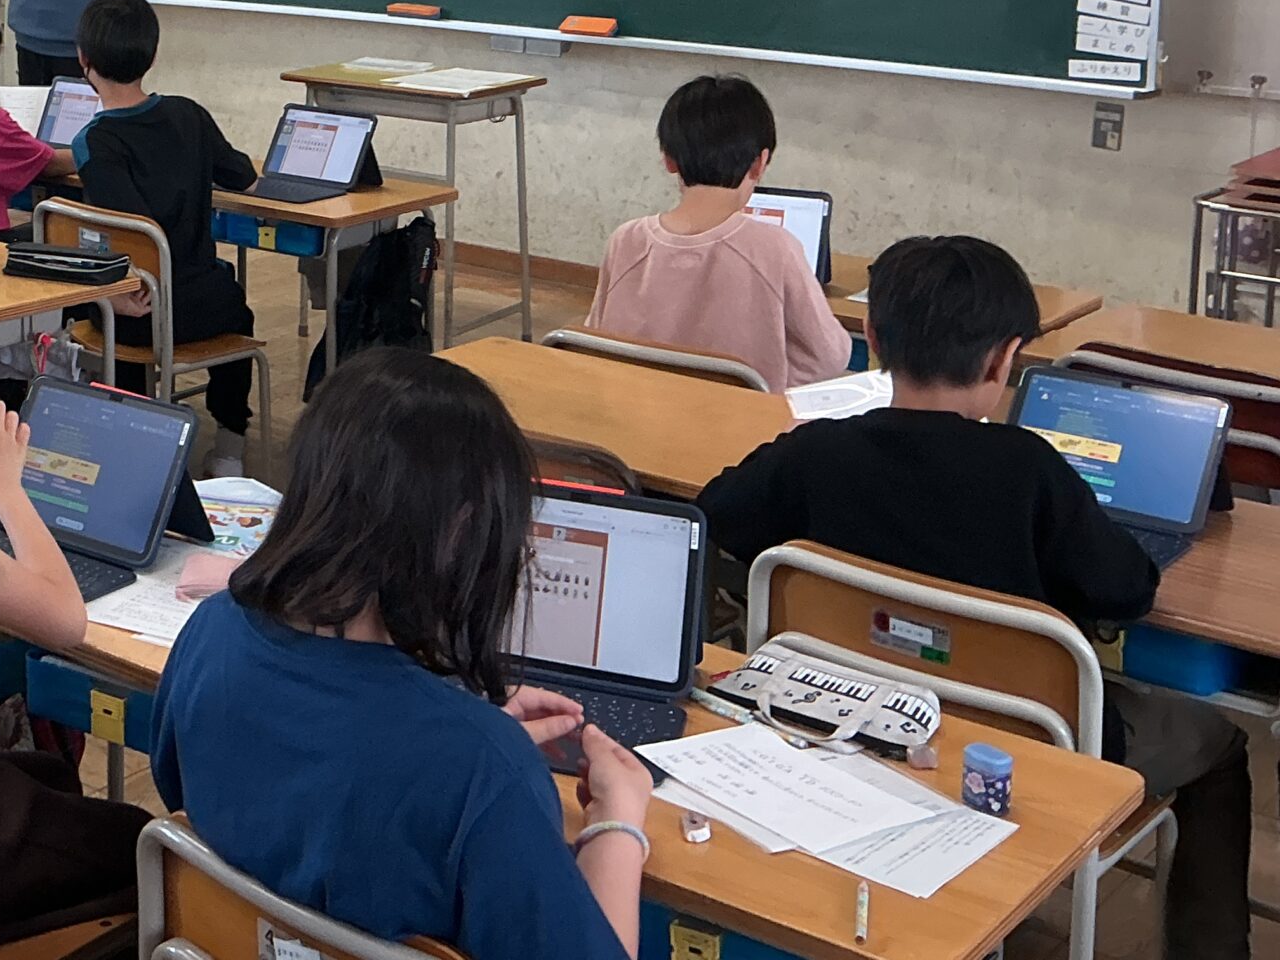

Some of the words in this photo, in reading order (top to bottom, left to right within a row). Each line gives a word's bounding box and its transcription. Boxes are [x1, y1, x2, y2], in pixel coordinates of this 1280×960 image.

[1083, 21, 1145, 38] 一人学び
[1091, 38, 1136, 54] まとめ
[1077, 62, 1132, 76] ふりかえり
